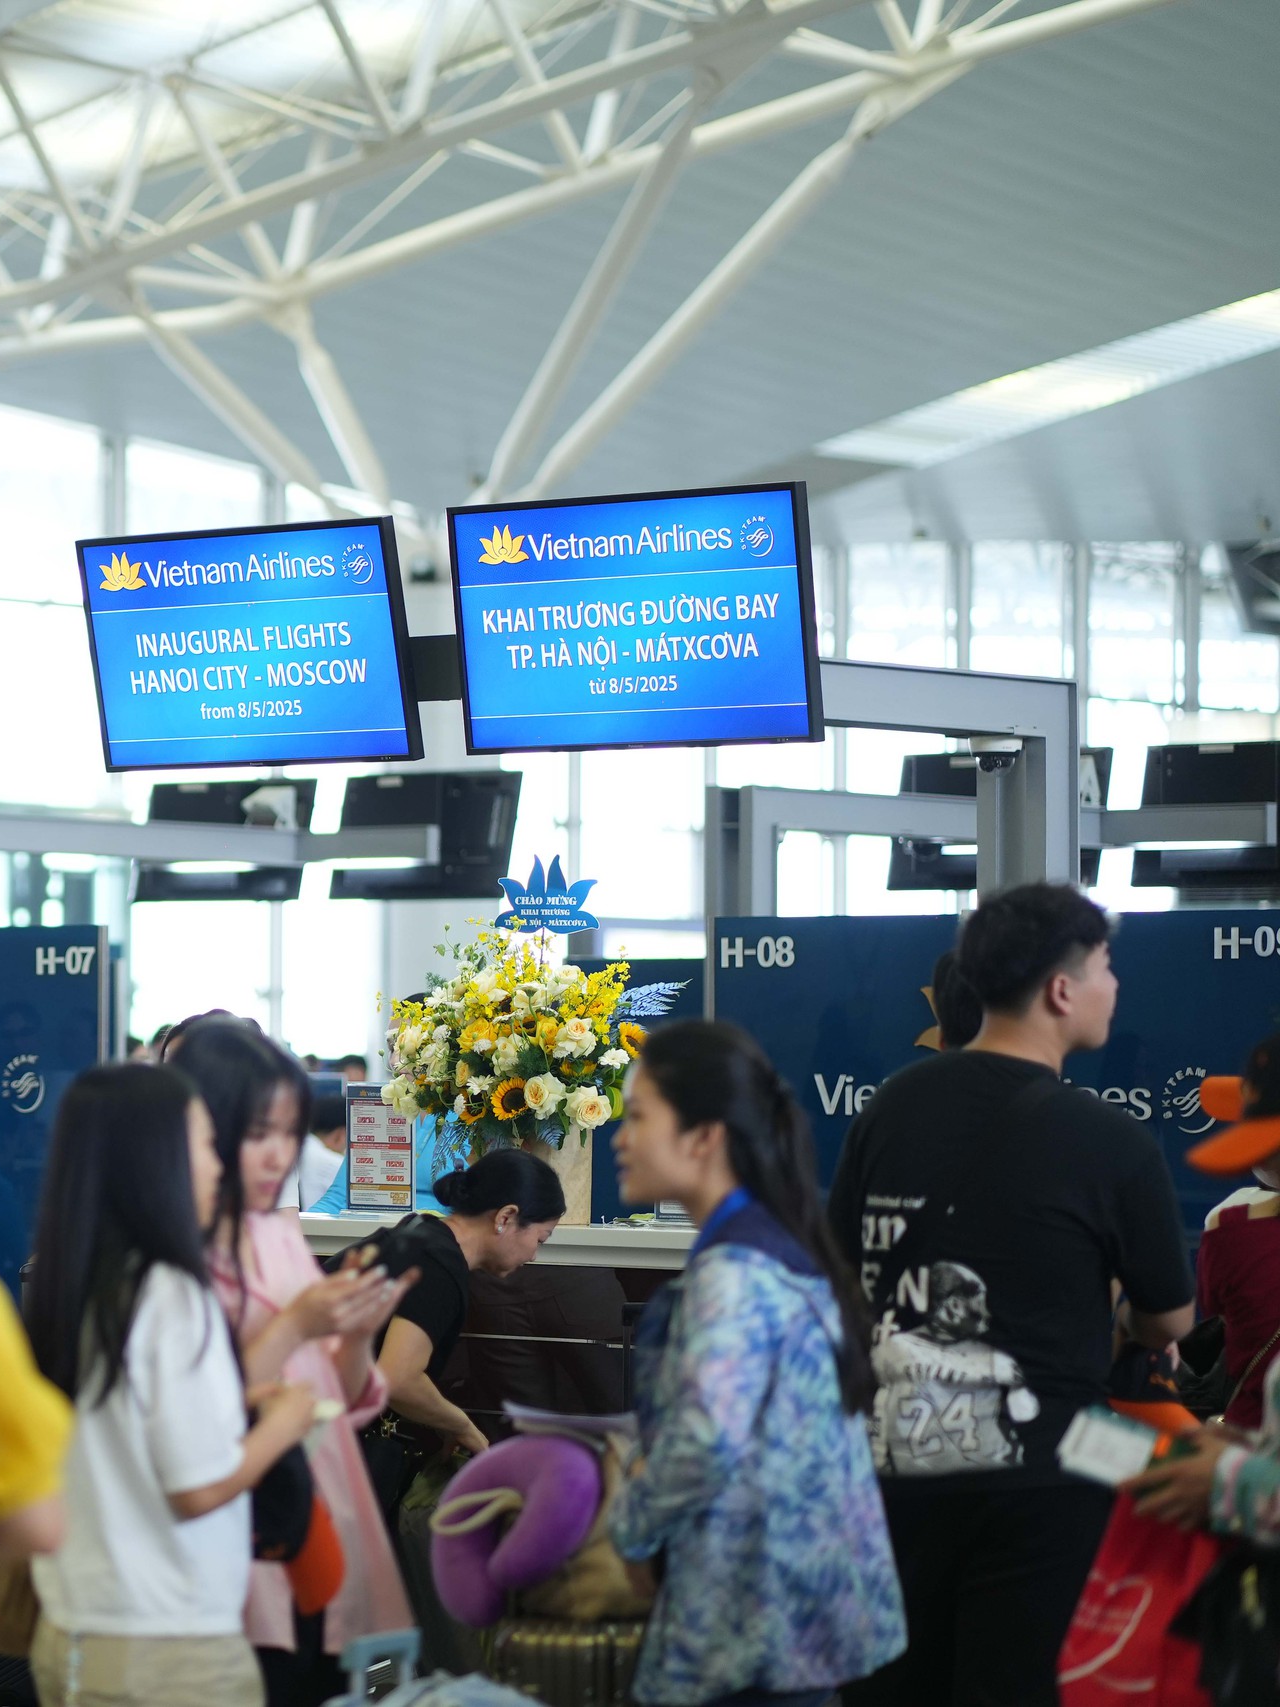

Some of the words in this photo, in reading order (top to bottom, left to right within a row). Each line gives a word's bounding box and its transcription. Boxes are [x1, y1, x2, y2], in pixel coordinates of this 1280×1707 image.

[527, 533, 636, 561] Vietnam
[636, 524, 733, 555] Airlines
[144, 560, 246, 588] Vietnam
[246, 551, 335, 581] Airlines
[482, 606, 535, 634] KHAI
[538, 600, 636, 632] TRƯƠNG
[640, 593, 730, 625] ĐƯỜNG
[735, 592, 780, 620] BAY
[135, 628, 260, 658] INAUGURAL
[263, 621, 352, 651] FLIGHTS
[506, 644, 537, 670] TP.
[541, 637, 573, 667] HÀ
[577, 636, 617, 671] NỘI
[635, 631, 759, 663] MÁTXCƠVA
[129, 667, 199, 695] HANOI
[203, 665, 249, 691] CITY
[266, 658, 367, 688] MOSCOW
[588, 677, 607, 695] từ
[608, 674, 678, 694] 8/5/2025
[200, 703, 235, 720] from
[237, 699, 303, 719] 8/5/2025
[515, 894, 543, 905] CHÀO
[546, 894, 577, 906] MỪNG
[35, 946, 97, 976] H-07
[720, 935, 796, 969] H-08
[898, 1392, 979, 1458] 24
